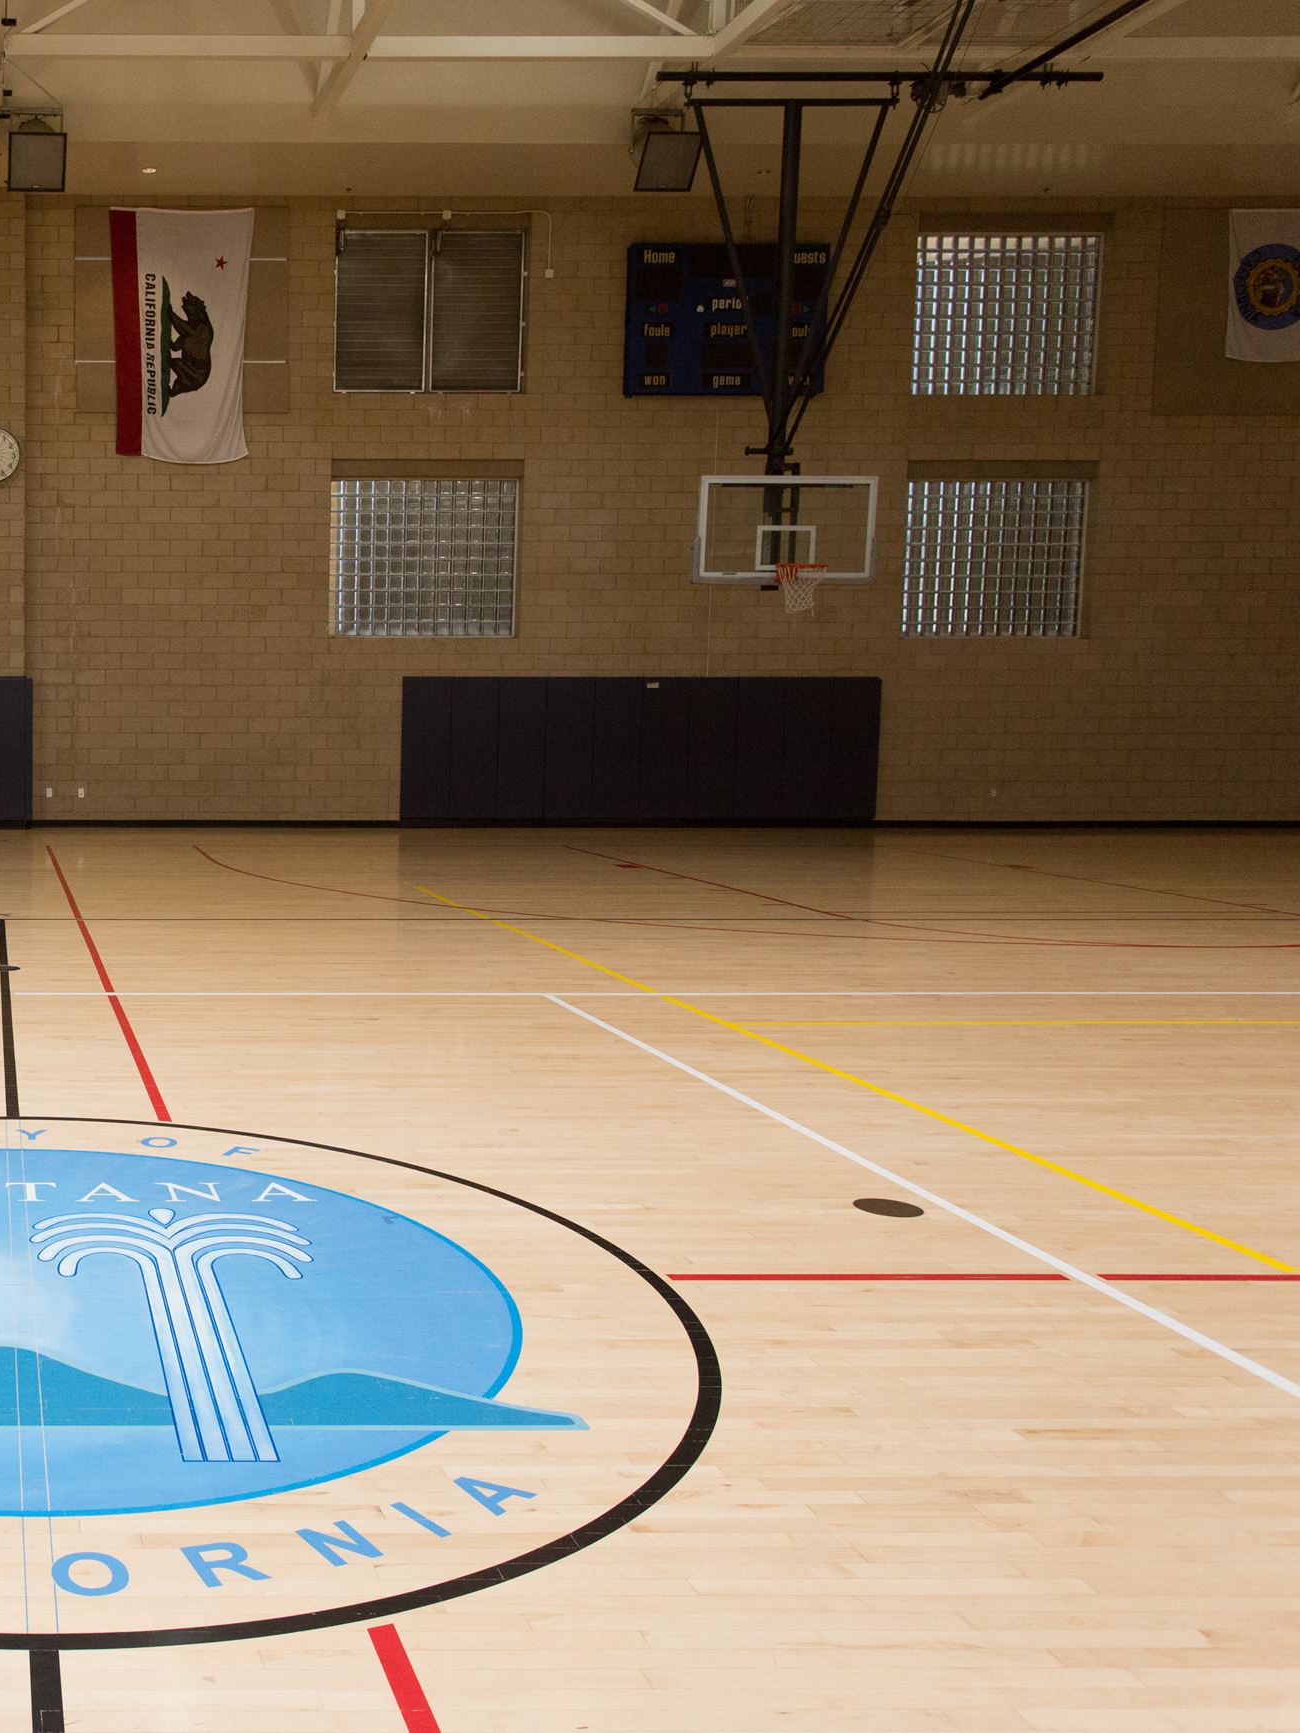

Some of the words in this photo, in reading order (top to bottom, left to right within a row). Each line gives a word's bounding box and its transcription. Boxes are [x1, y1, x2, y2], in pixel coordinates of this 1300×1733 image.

[644, 250, 675, 263] Home
[793, 251, 826, 265] uests
[145, 273, 156, 350] CALIFORNIA
[711, 296, 749, 312] perio
[644, 323, 670, 337] fouls
[710, 322, 747, 338] player
[146, 352, 157, 415] REPUBLIC
[644, 374, 666, 386] won
[712, 374, 742, 389] game
[140, 1137, 261, 1158] OF
